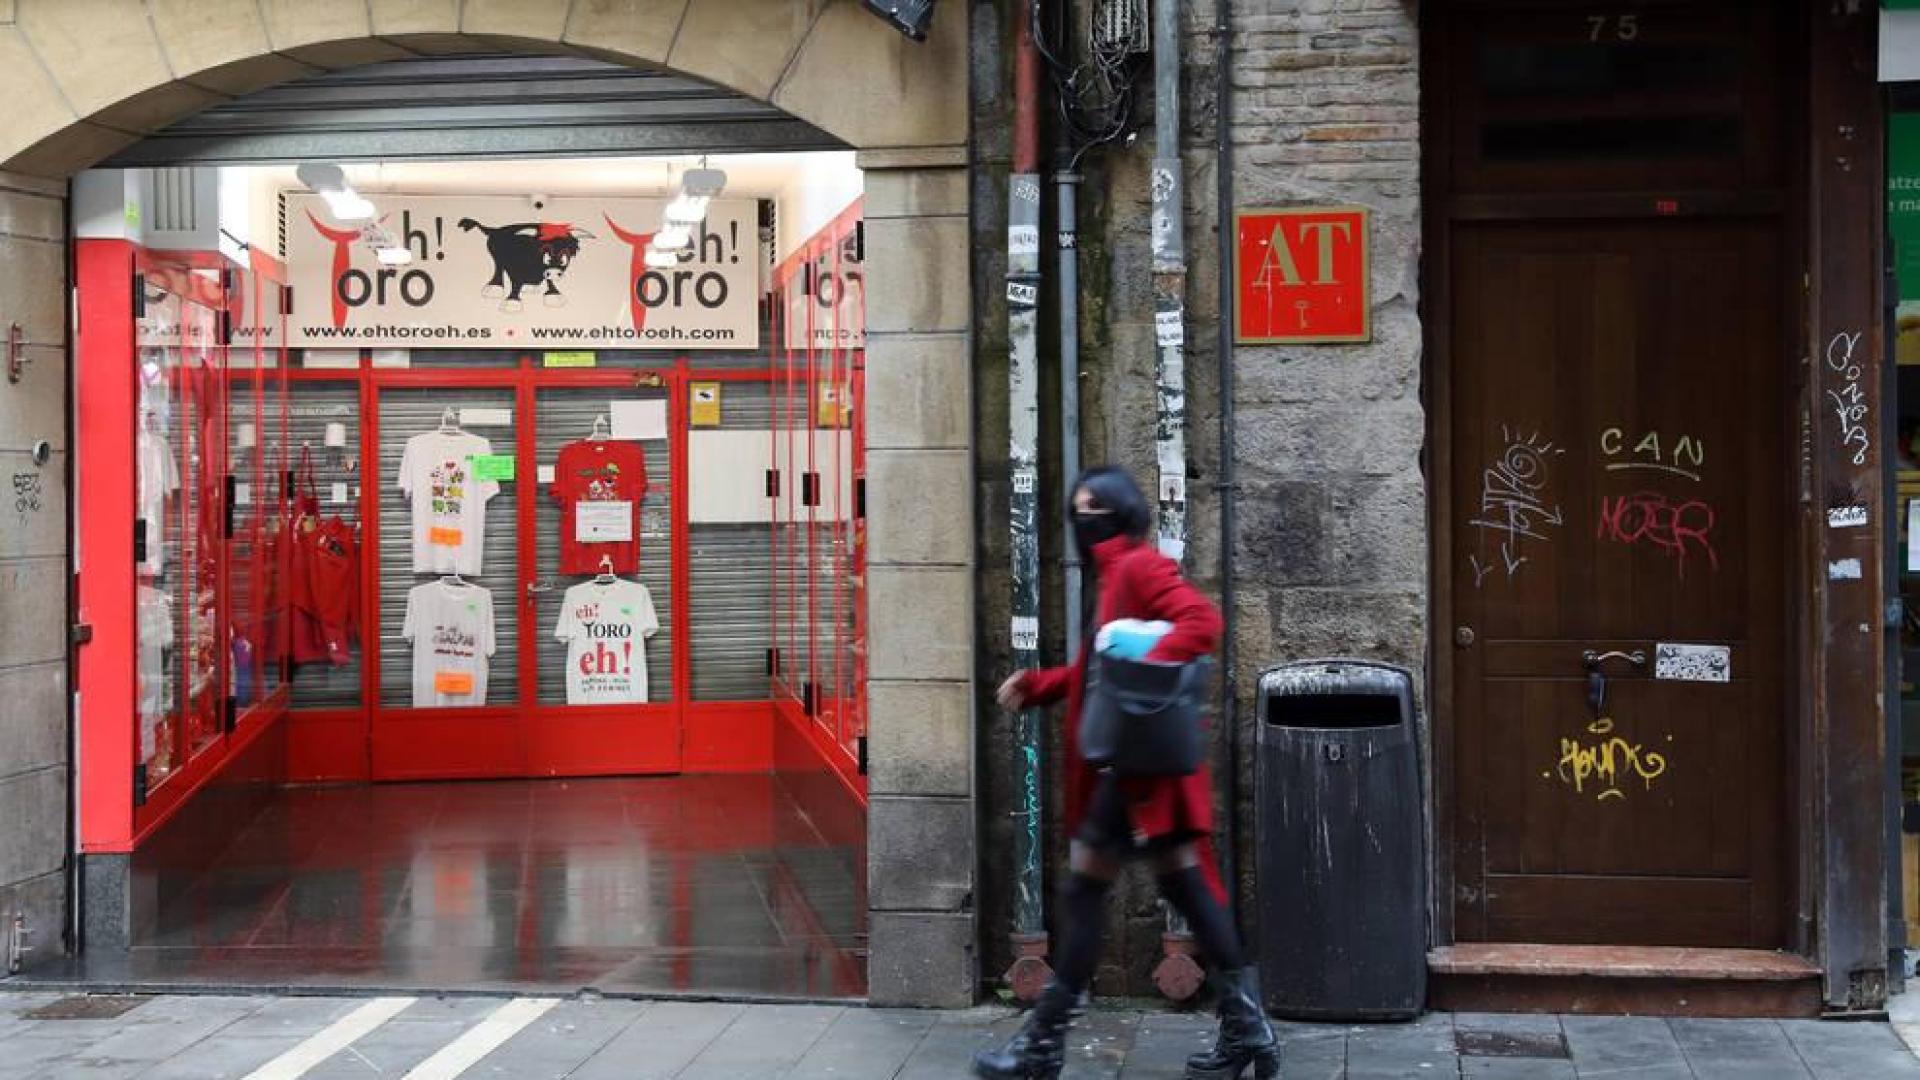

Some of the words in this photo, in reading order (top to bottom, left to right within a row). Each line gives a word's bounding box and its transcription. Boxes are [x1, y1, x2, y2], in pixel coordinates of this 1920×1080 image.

[1586, 15, 1638, 42] 75
[1252, 222, 1351, 286] AT
[303, 325, 491, 338] www.ehtoroeh.es
[532, 326, 734, 339] www.ehtoroeh.com
[1601, 427, 1703, 466] CAN
[582, 621, 632, 638] TORO
[579, 641, 632, 676] eh!
